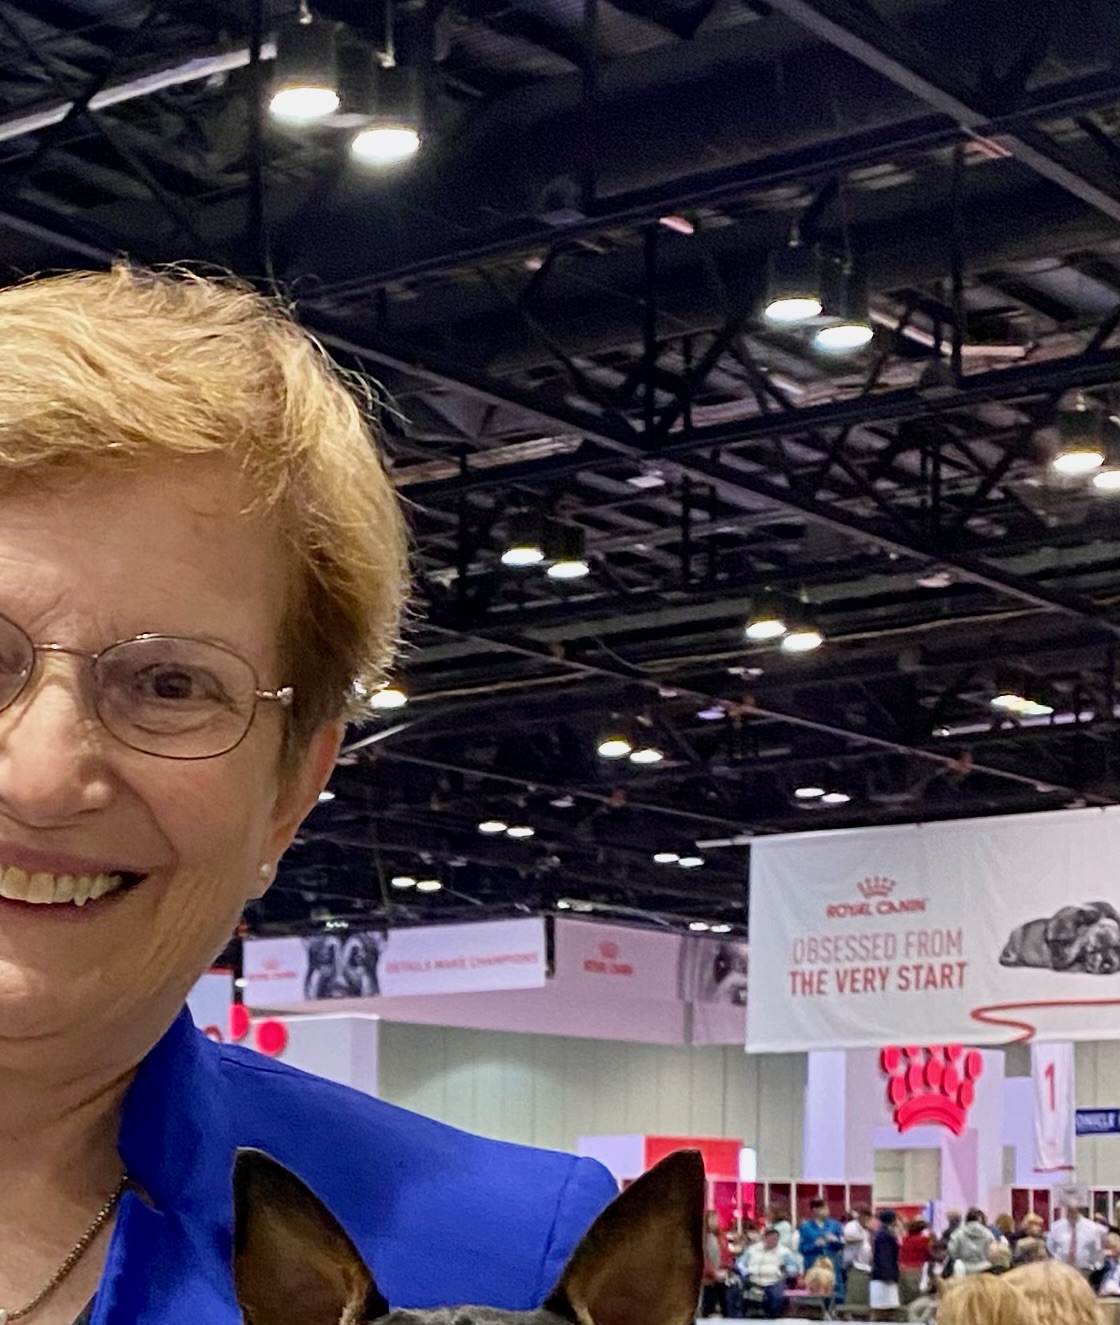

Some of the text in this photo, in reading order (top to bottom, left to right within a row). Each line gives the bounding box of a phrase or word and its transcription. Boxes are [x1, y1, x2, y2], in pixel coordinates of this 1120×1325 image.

[826, 899, 926, 918] ROYAL CANIN
[792, 927, 963, 965] OBSESSED FROM
[789, 961, 968, 996] THE VERY START
[1044, 1062, 1056, 1111] 1
